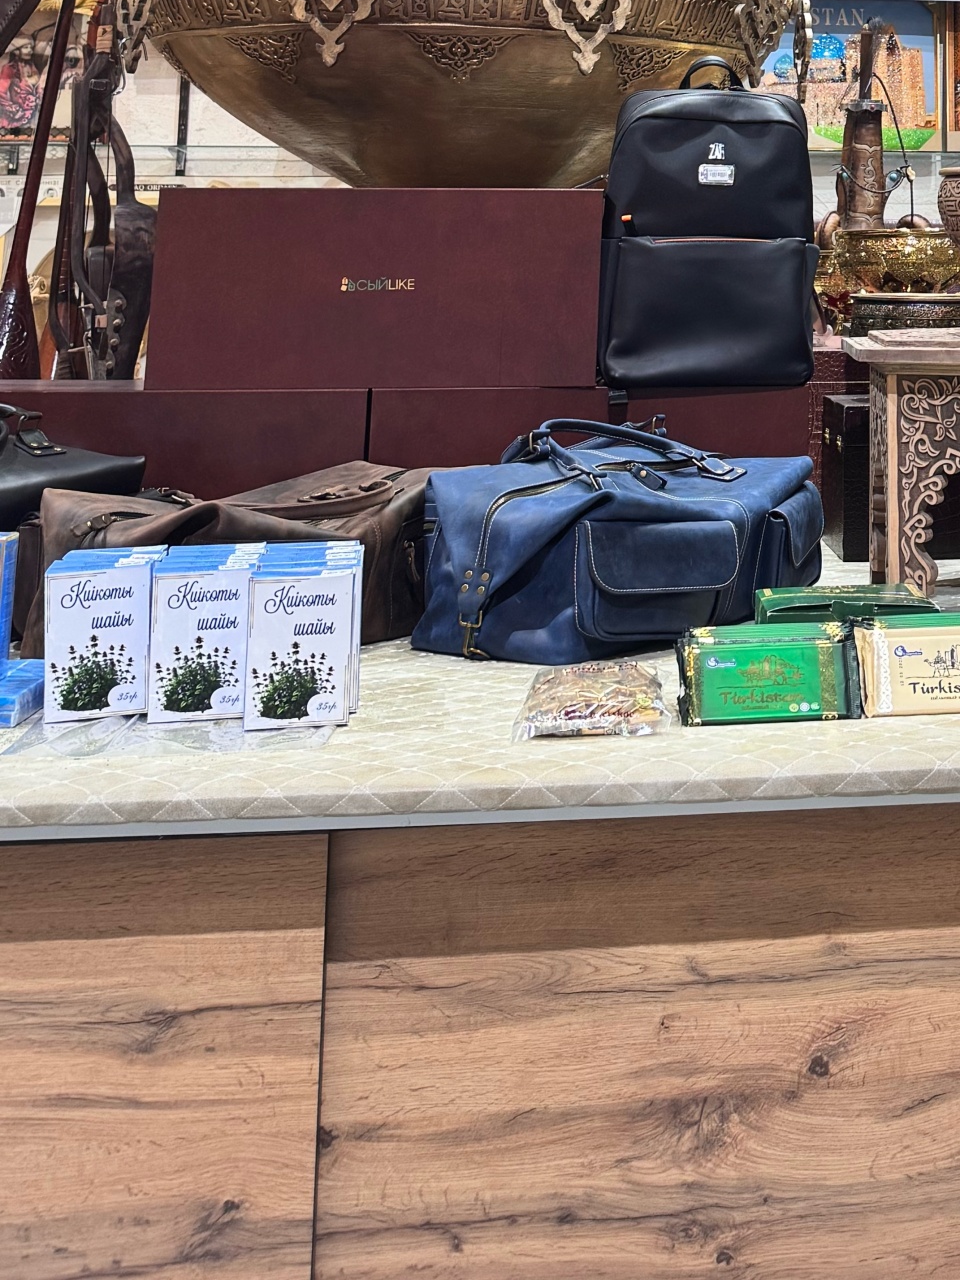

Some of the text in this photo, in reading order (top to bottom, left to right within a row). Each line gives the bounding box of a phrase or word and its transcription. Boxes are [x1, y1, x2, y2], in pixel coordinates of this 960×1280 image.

[811, 7, 864, 26] STAN
[61, 580, 134, 609] Киікоты
[168, 581, 240, 610] Киікоты
[264, 585, 337, 615] Киікоты
[91, 611, 134, 630] шайы
[197, 613, 239, 631] шайы
[293, 618, 336, 636] шайы
